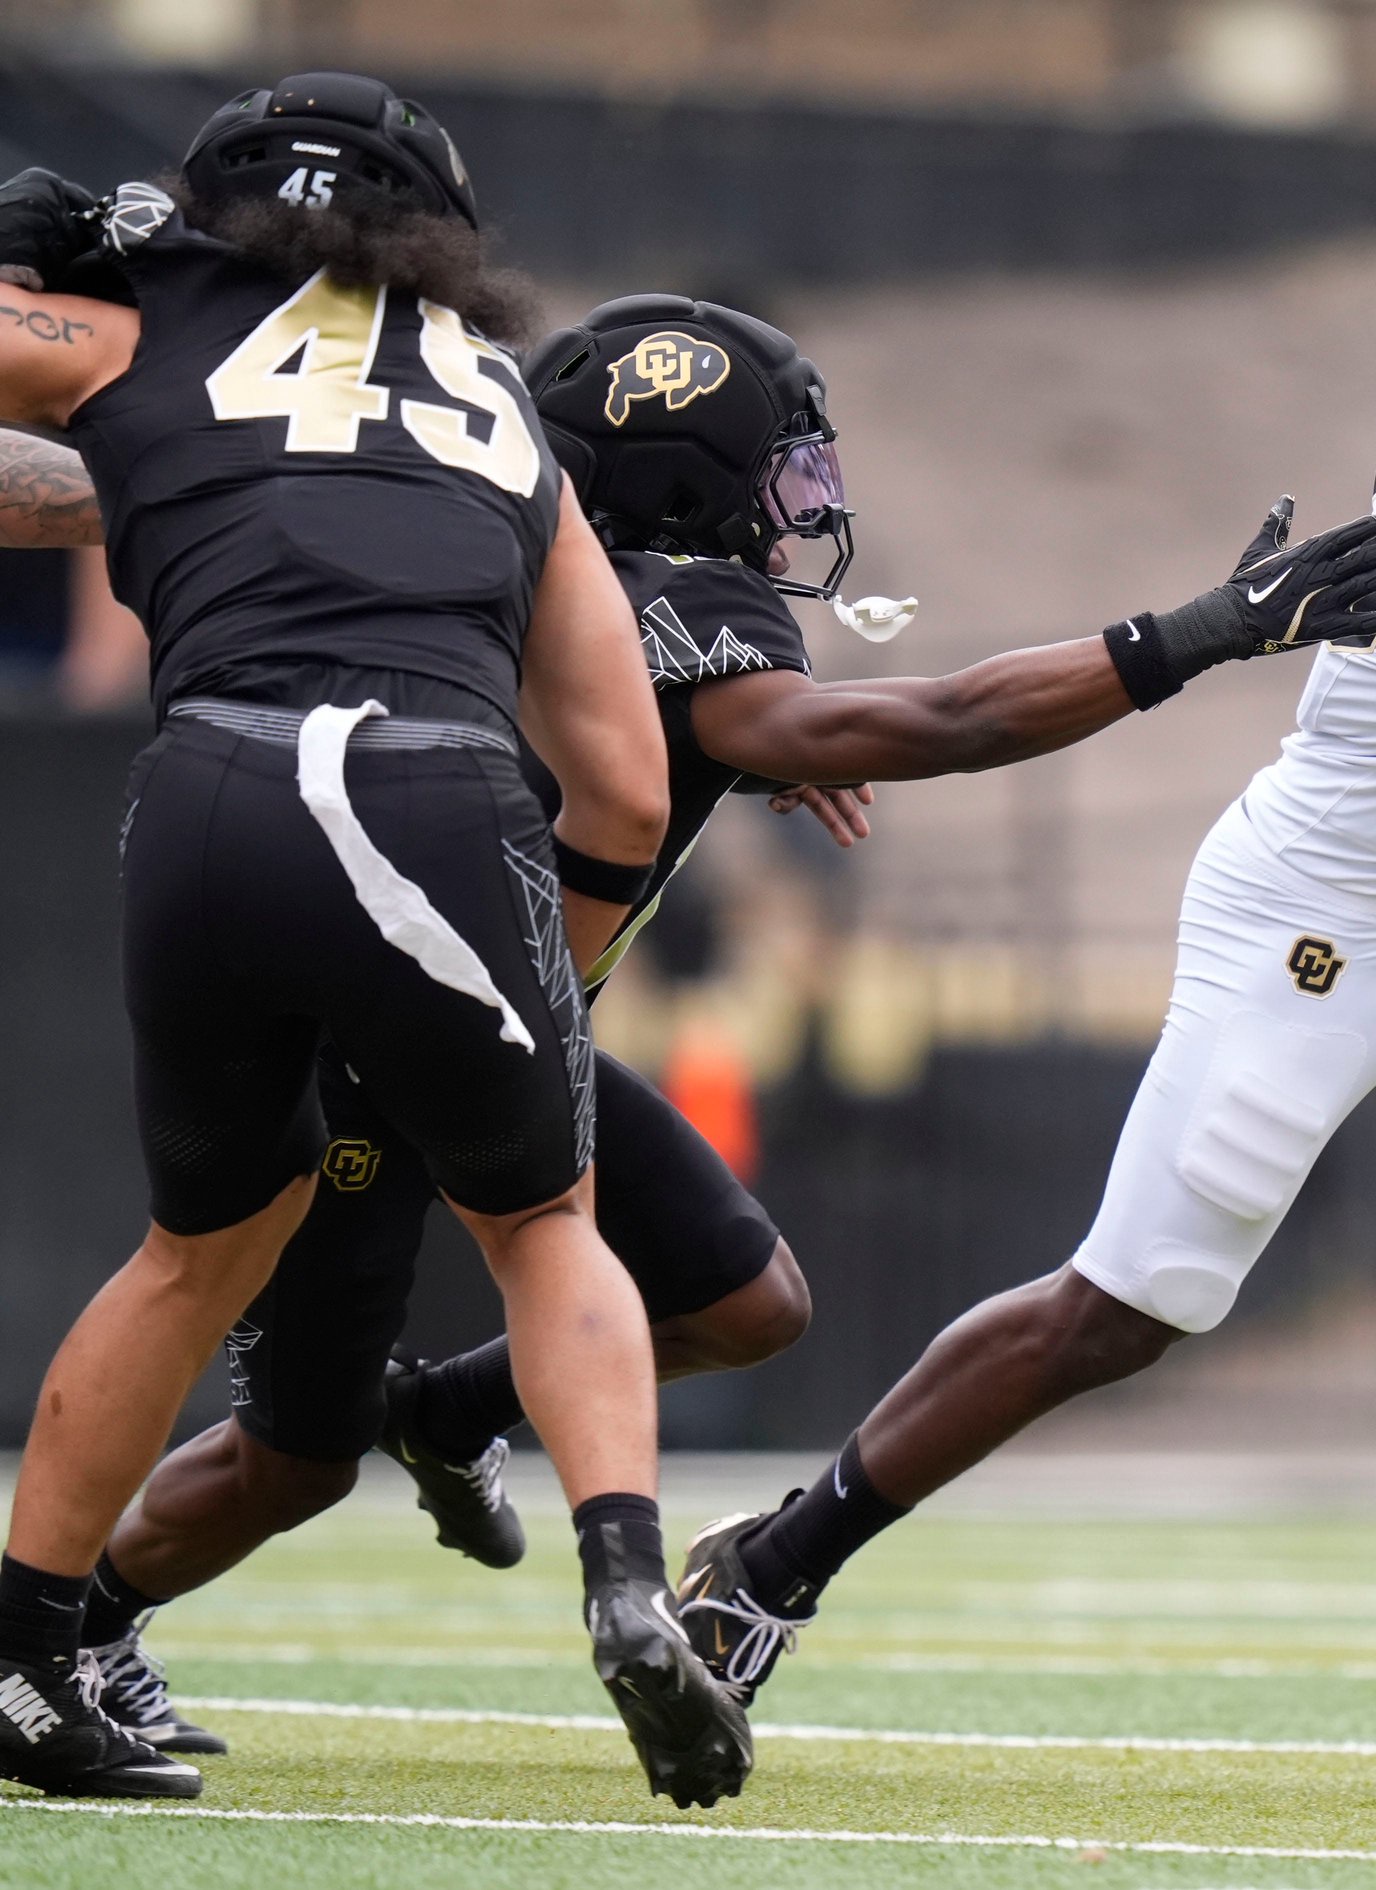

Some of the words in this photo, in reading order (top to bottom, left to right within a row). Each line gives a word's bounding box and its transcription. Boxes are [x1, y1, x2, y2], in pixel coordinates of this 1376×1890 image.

[278, 167, 337, 209] 45
[205, 264, 540, 498] 45
[636, 340, 693, 390] CU
[1285, 934, 1347, 997] CU
[322, 1138, 382, 1190] CU
[0, 1672, 63, 1745] NIKE
